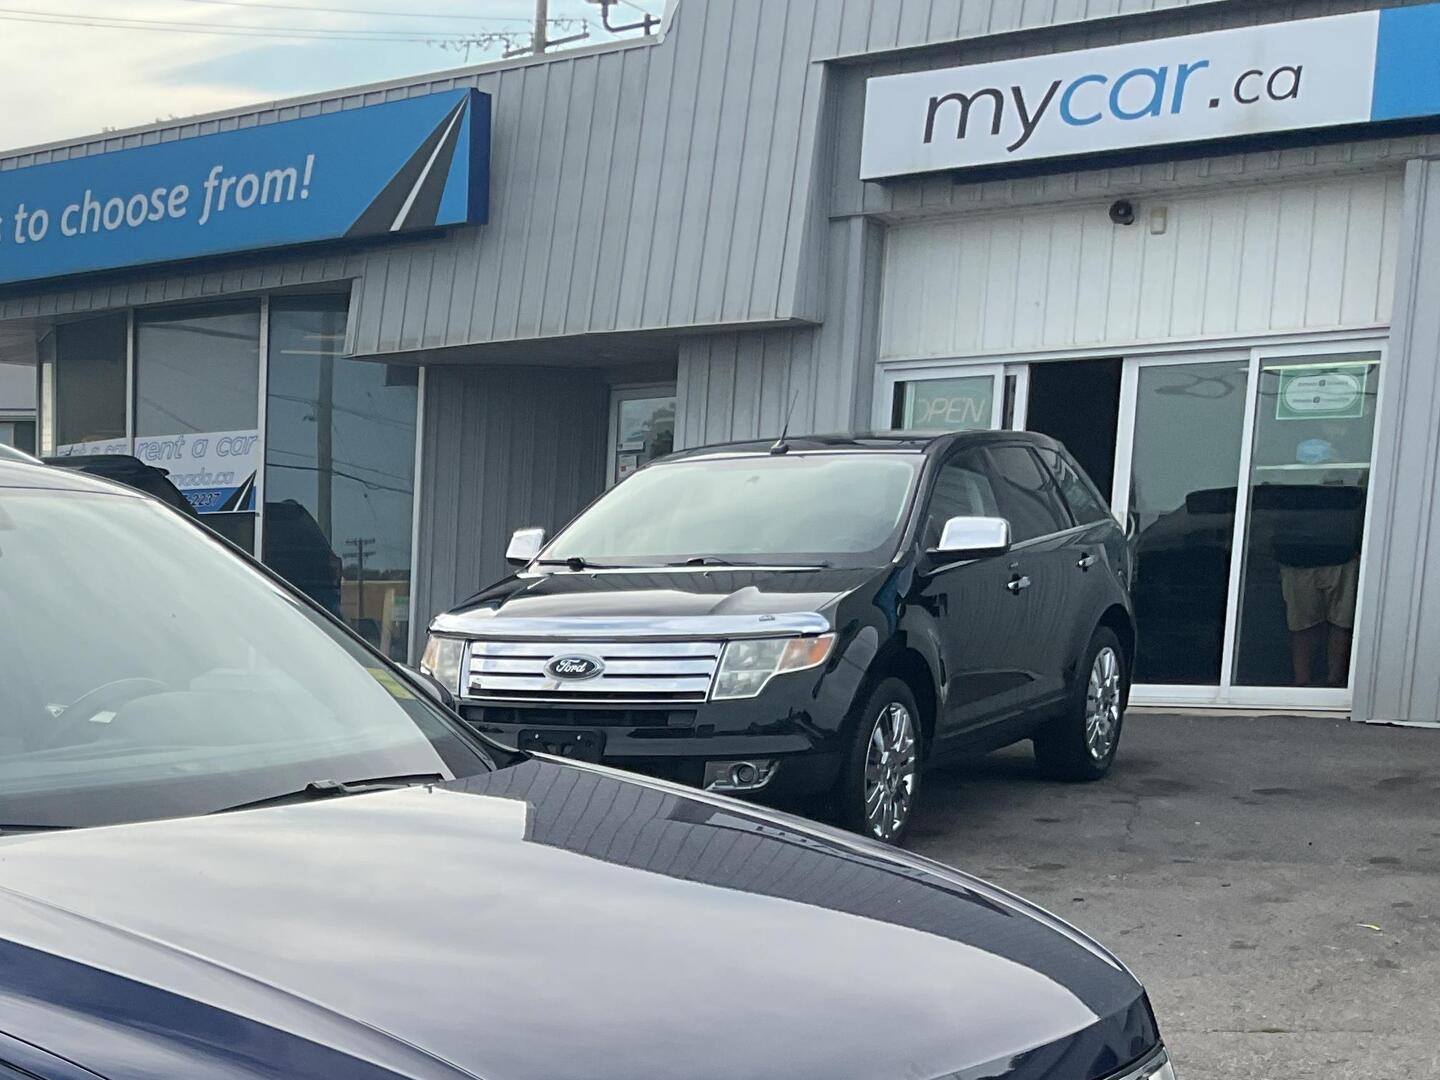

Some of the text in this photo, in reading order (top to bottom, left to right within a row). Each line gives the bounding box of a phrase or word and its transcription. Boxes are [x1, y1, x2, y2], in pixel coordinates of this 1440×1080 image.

[923, 60, 1303, 152] mycar.ca
[15, 201, 49, 245] to
[60, 184, 189, 236] choose
[197, 154, 316, 226] from!
[136, 434, 185, 461] rent
[192, 438, 209, 459] a
[216, 435, 258, 457] car
[170, 467, 236, 487] nada.ca
[555, 659, 588, 673] Ford
